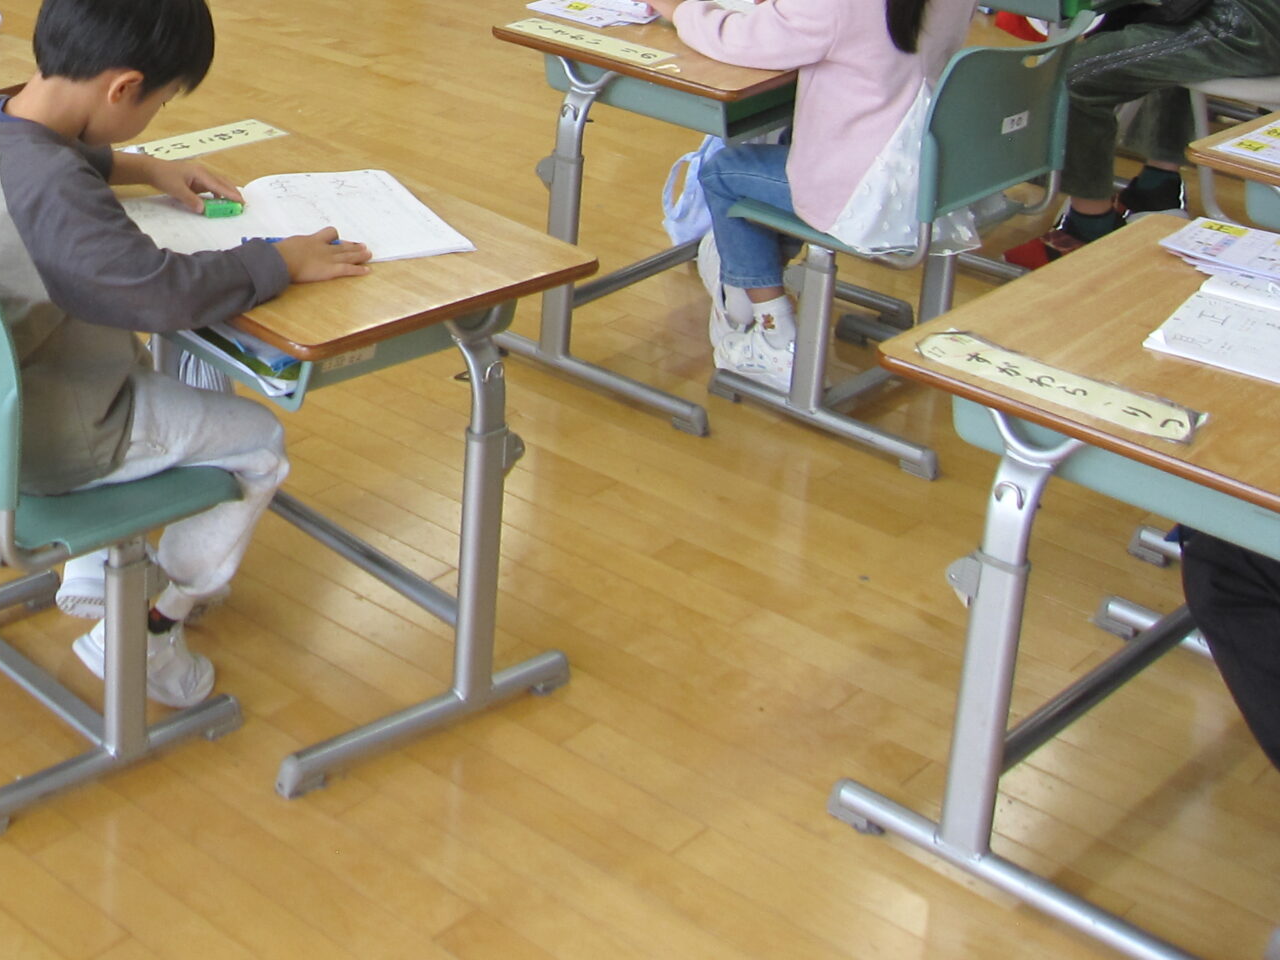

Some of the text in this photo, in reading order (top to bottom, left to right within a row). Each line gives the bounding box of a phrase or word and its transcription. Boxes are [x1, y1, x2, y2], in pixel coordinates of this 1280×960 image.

[966, 350, 1187, 430] すがわら りつ
